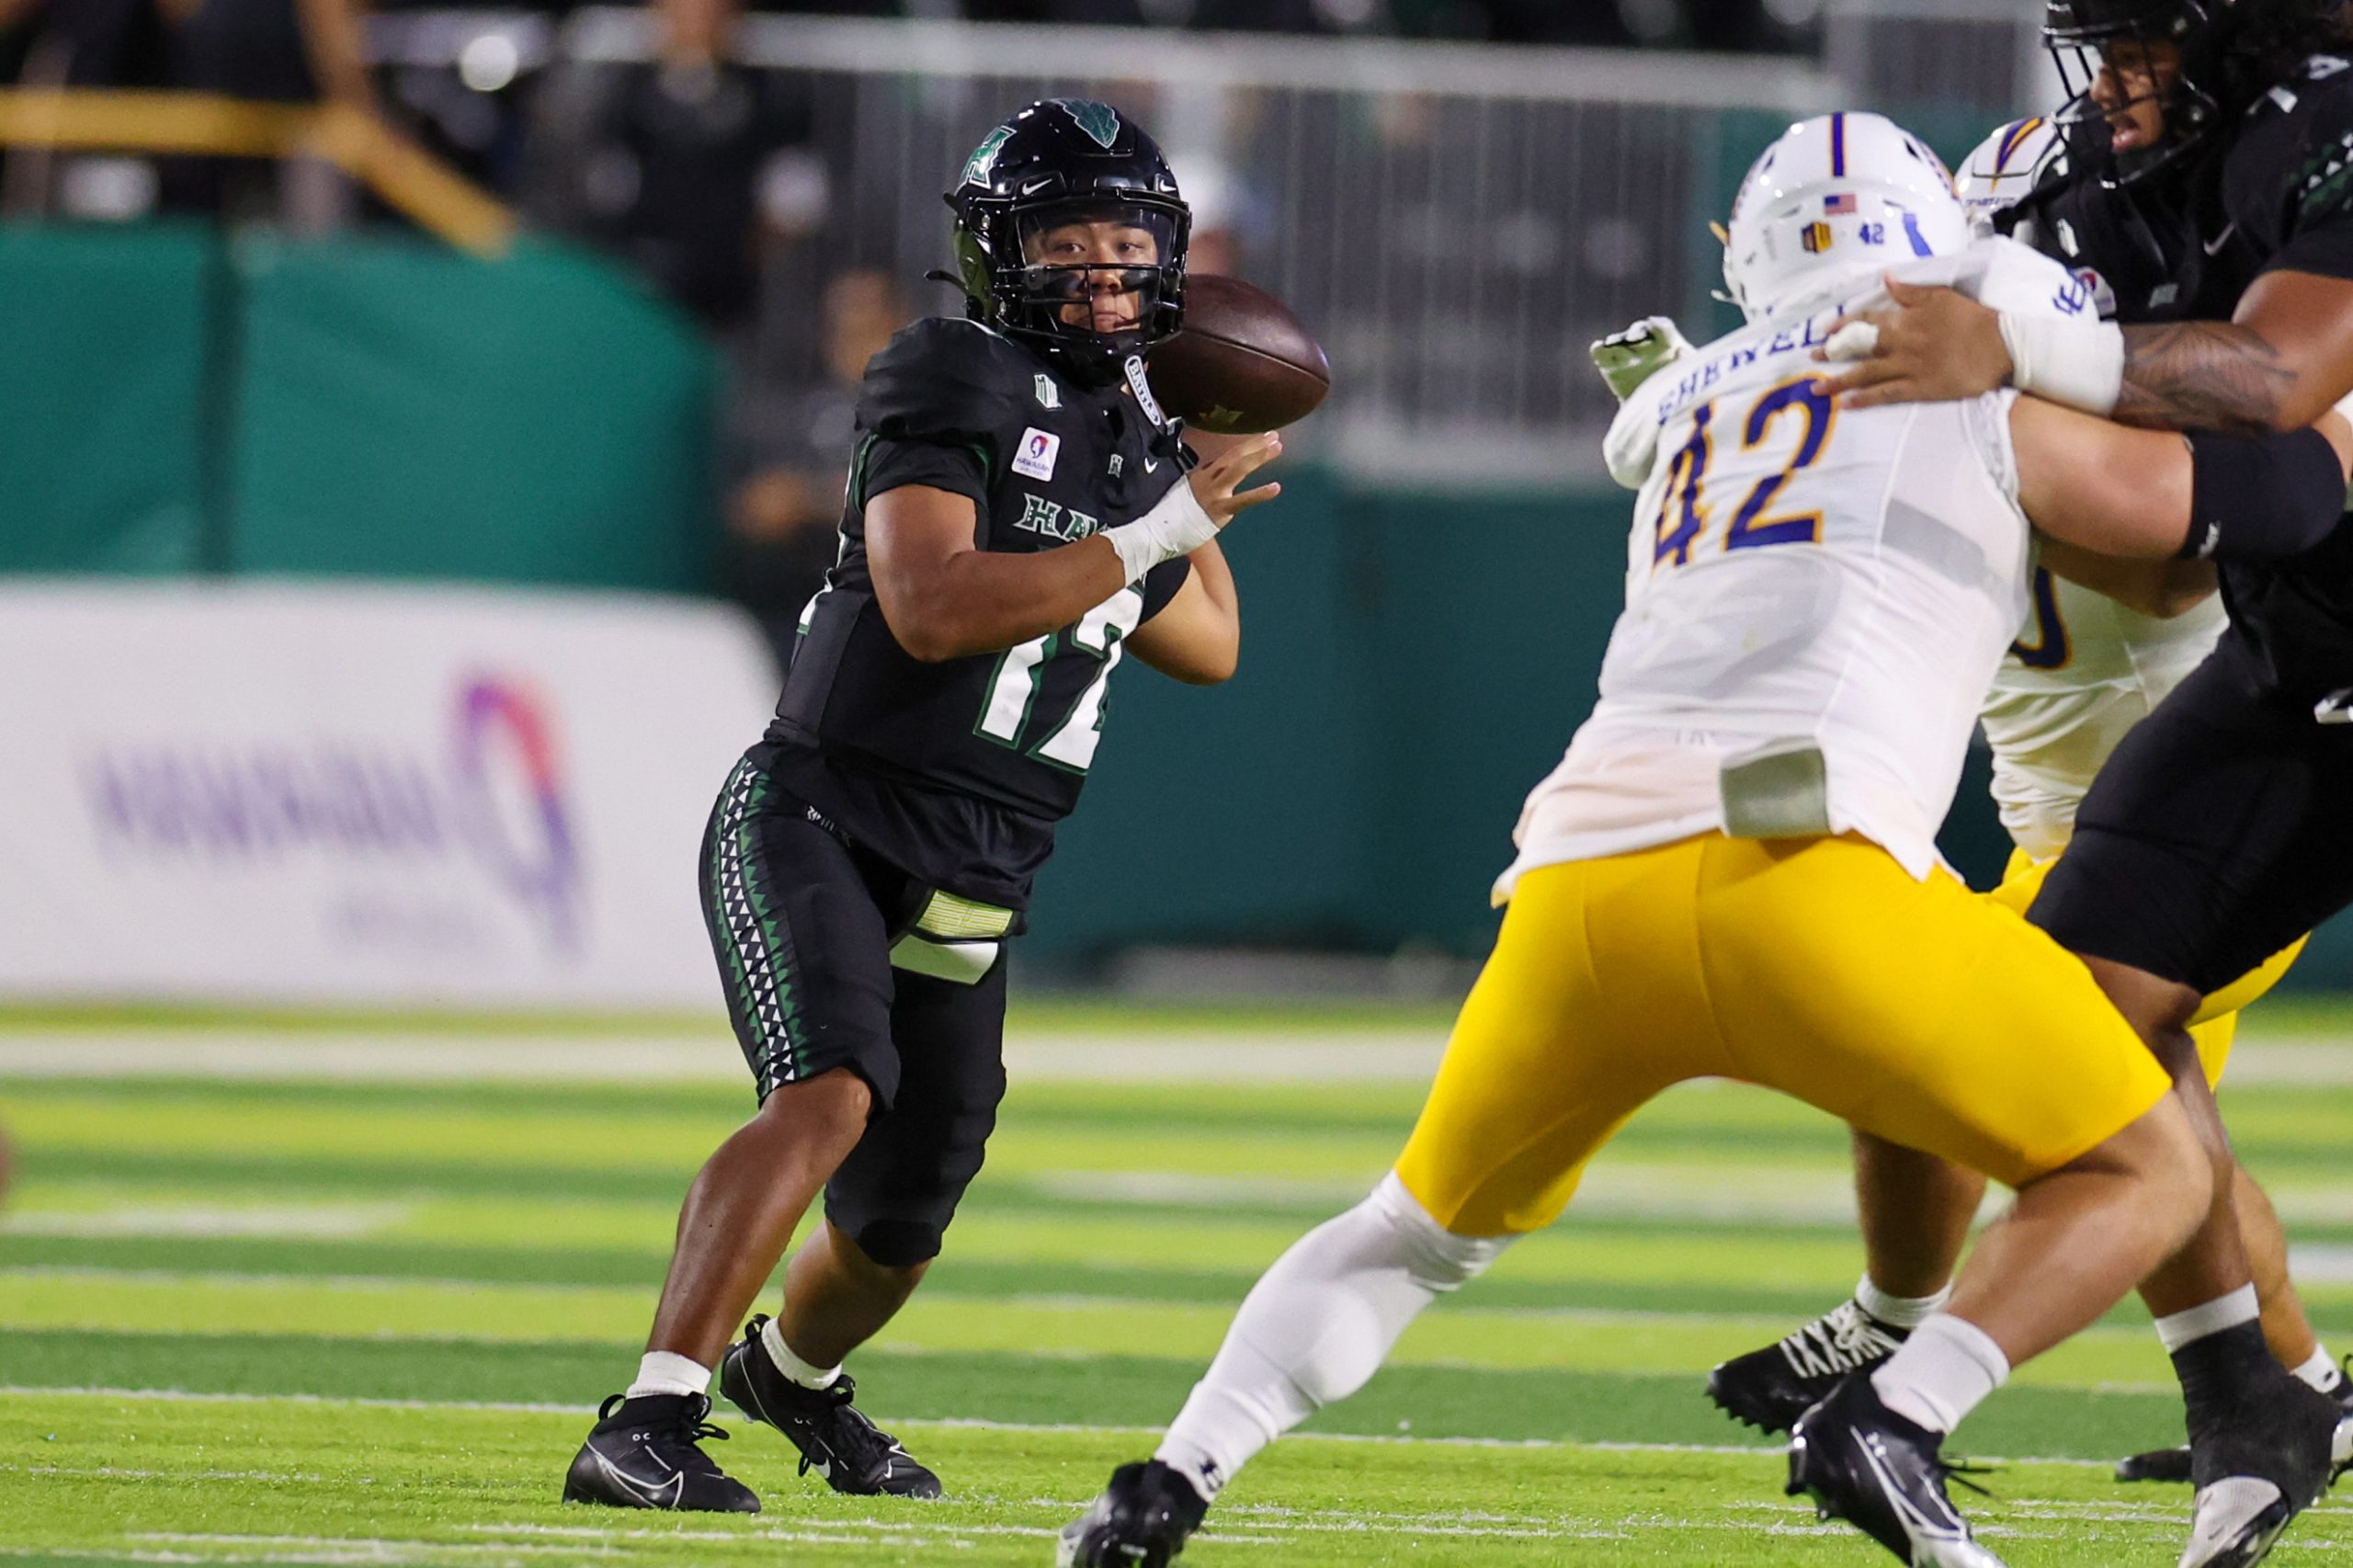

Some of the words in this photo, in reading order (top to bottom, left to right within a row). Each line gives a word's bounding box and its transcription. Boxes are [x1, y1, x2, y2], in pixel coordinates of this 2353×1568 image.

[1859, 222, 1884, 245] 42
[1127, 360, 1159, 422] BATTLE
[1652, 372, 1837, 572] 42
